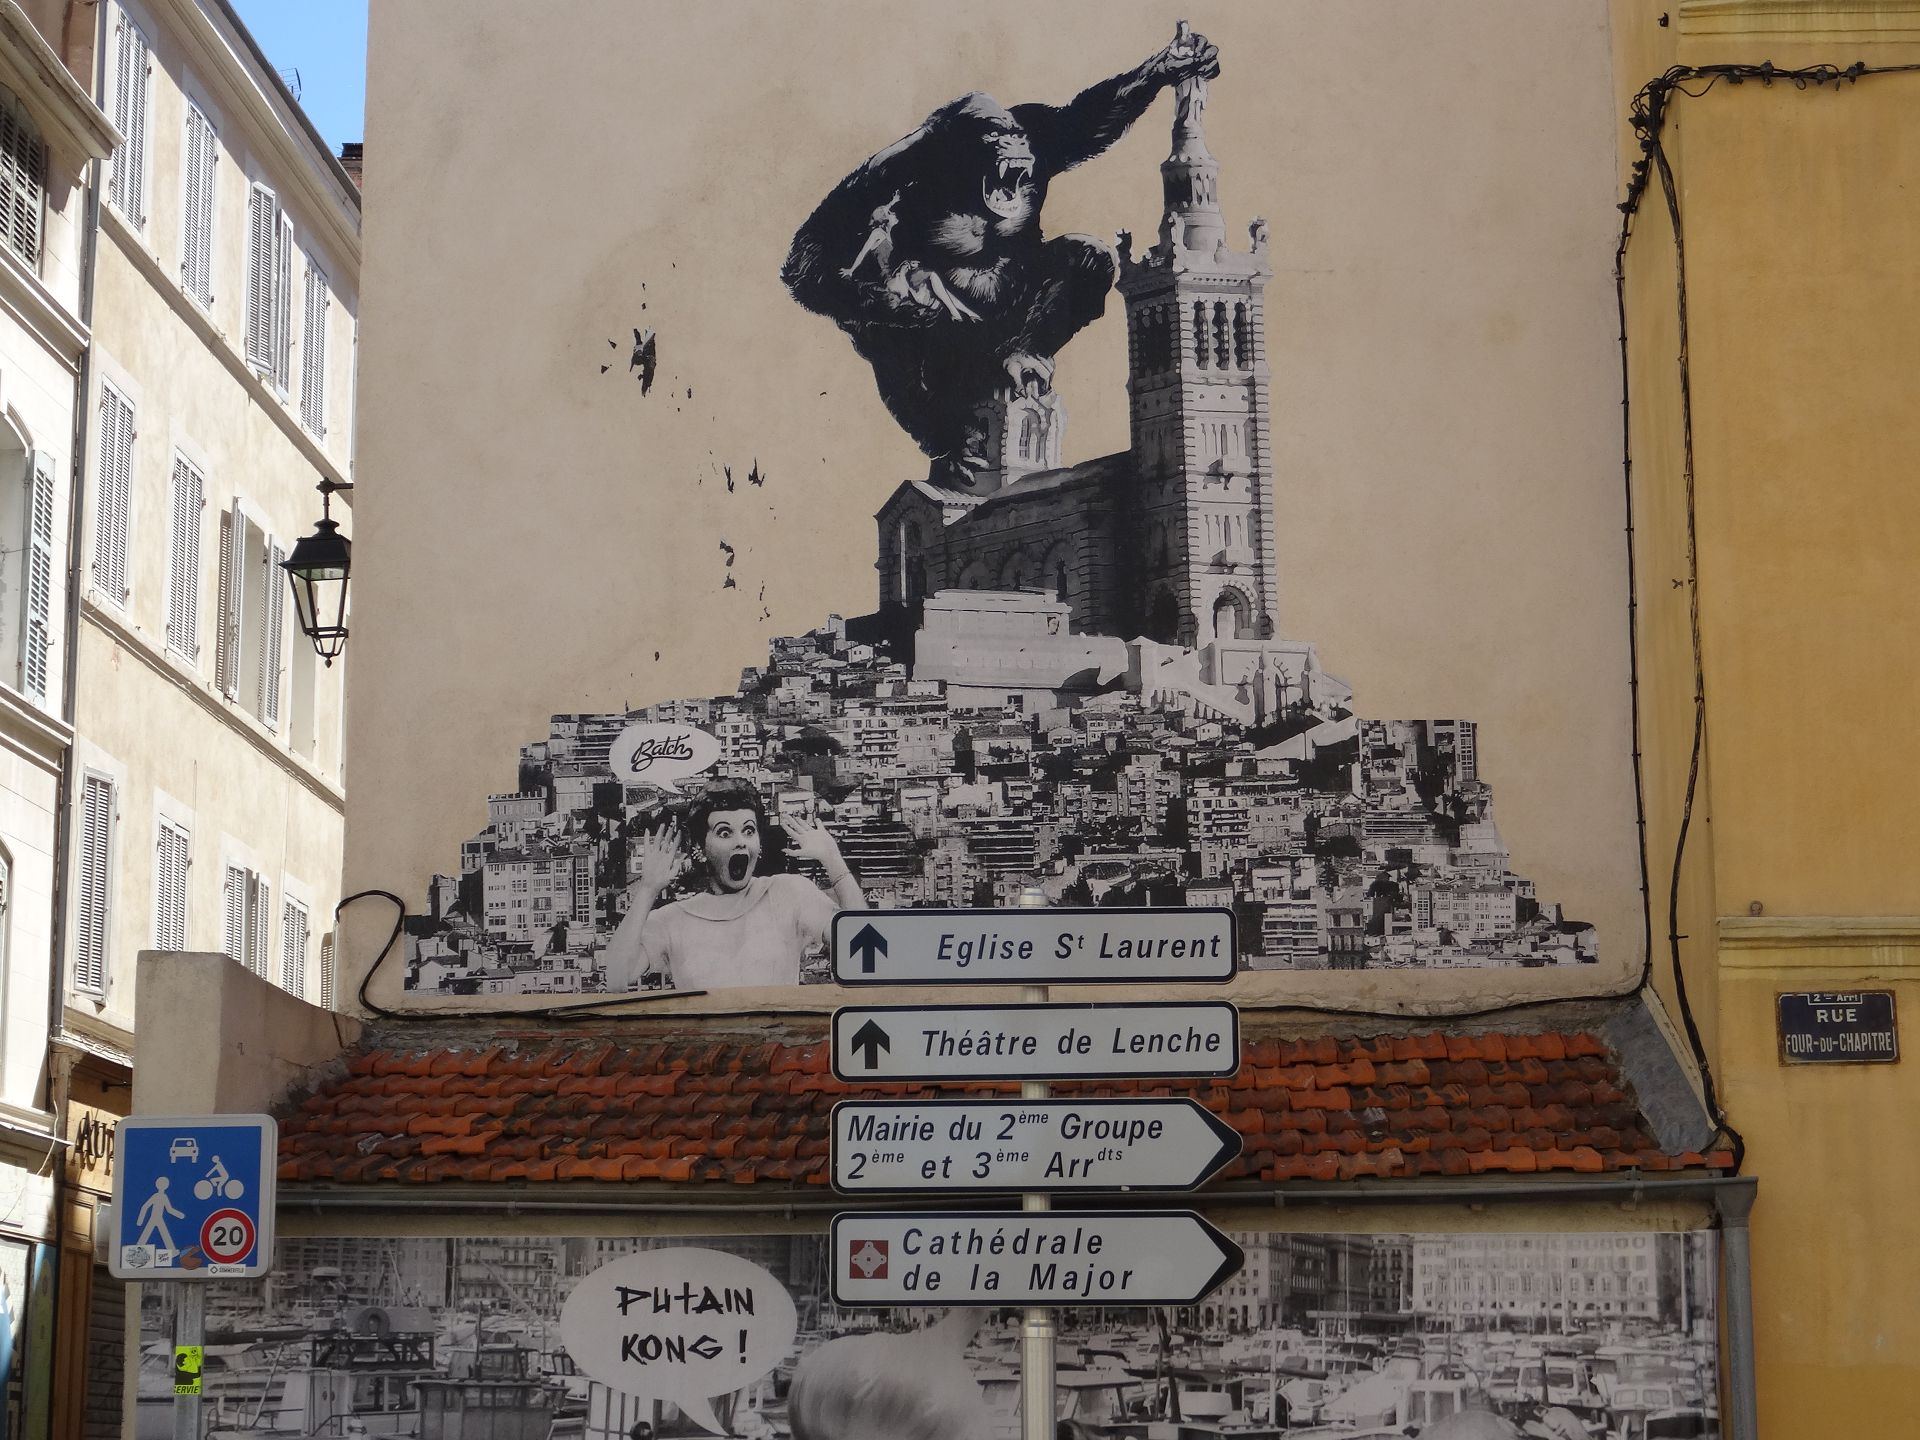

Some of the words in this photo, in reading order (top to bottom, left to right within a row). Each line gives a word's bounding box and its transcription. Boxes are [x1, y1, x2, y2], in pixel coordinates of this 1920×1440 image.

[631, 734, 693, 772] Batch
[937, 933, 1033, 967] Eglise
[1099, 932, 1221, 959] Laurent
[1816, 1008, 1857, 1023] RUE
[922, 1029, 1037, 1057] Théâtre
[1057, 1027, 1092, 1055] de
[1111, 1026, 1221, 1054] Lenche
[1785, 1032, 1892, 1053] FOUR-DU-CHAPITRE
[847, 1114, 935, 1142] Mairie
[948, 1114, 982, 1141] du
[1060, 1112, 1163, 1147] Groupe
[921, 1155, 953, 1180] et
[213, 1226, 244, 1247] 20
[902, 1227, 1103, 1256] Cathédrale
[902, 1263, 941, 1292] de
[970, 1263, 1000, 1291] la
[1028, 1263, 1134, 1297] Major
[621, 1333, 723, 1365] KONG
